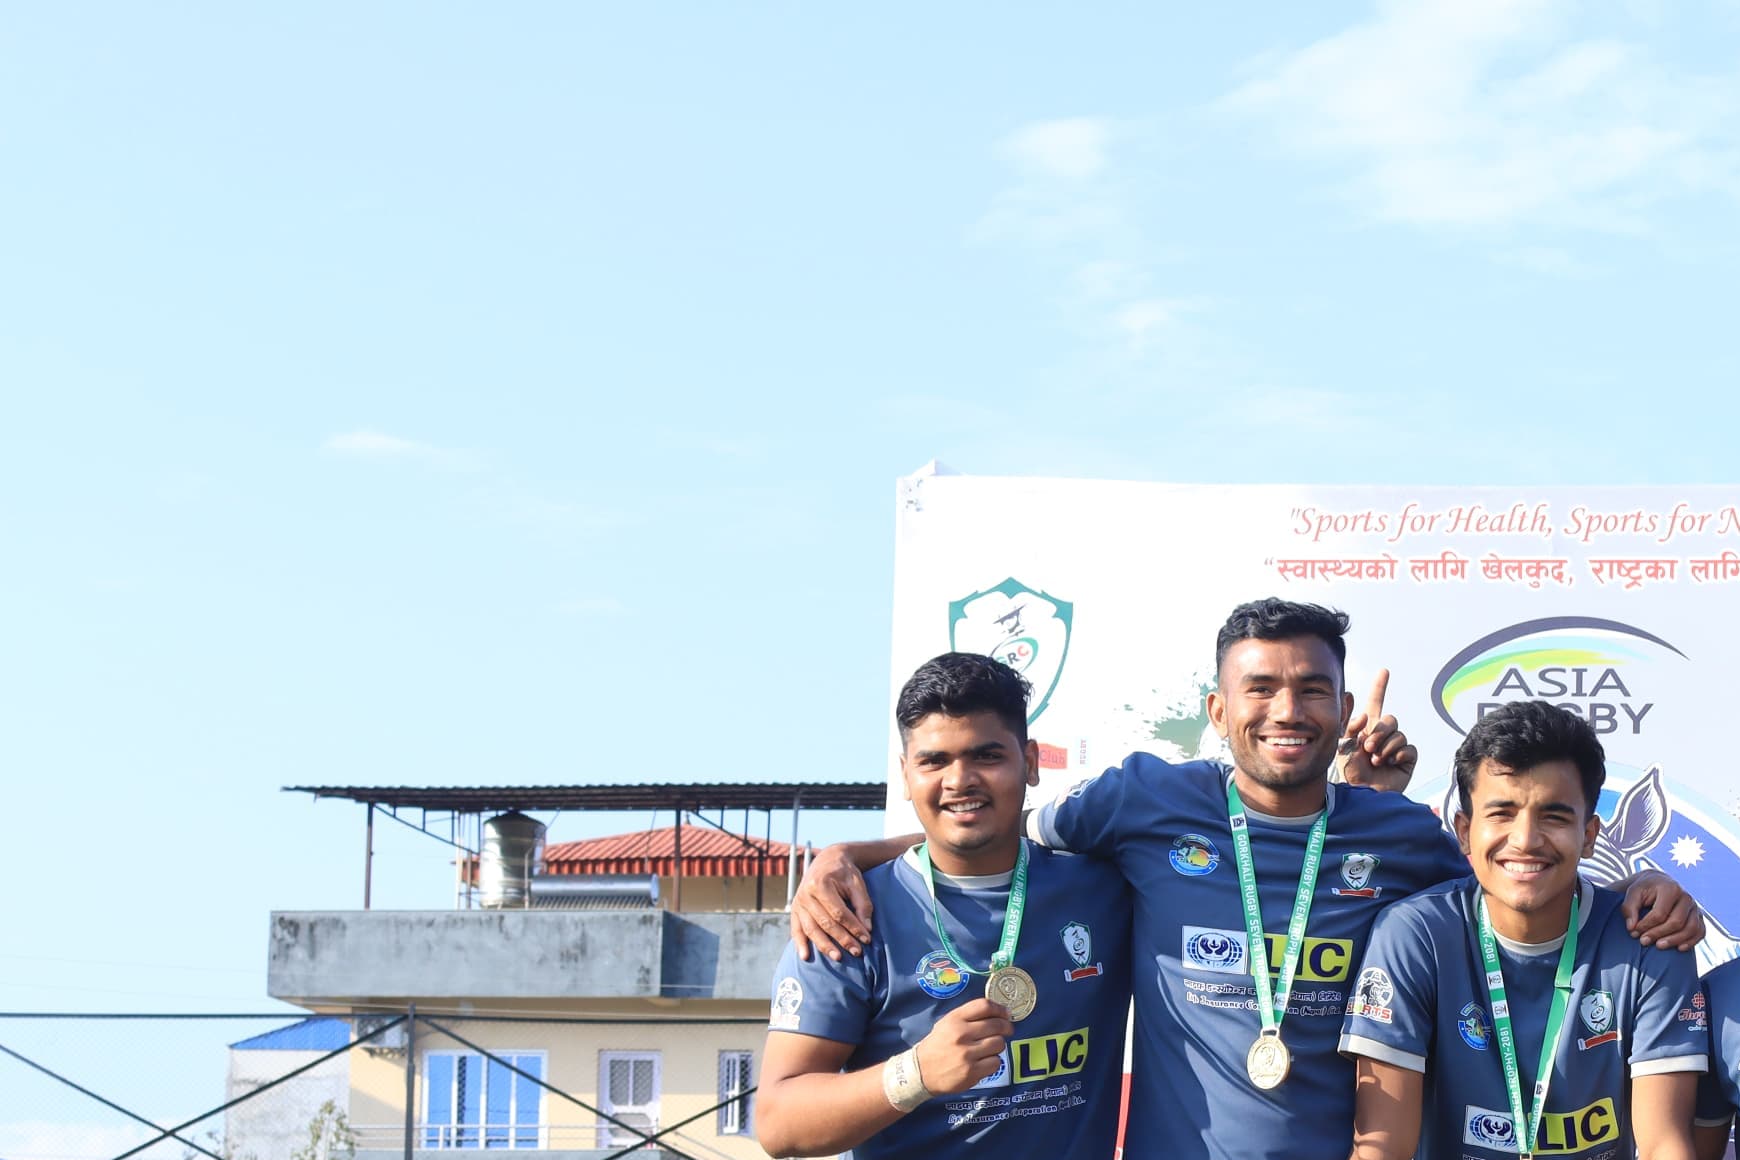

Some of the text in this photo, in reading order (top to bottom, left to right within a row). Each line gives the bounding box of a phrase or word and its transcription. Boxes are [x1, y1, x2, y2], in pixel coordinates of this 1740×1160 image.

[1291, 507, 1387, 542] "Sports
[1387, 503, 1442, 542] for
[1445, 504, 1553, 537] Health,
[1563, 507, 1657, 543] Sports
[1657, 503, 1712, 543] for
[1409, 551, 1469, 582] लागि
[1481, 553, 1573, 588] खेलकुद,
[1589, 559, 1678, 589] राष्ट्रका
[1492, 667, 1632, 697] ASIA
[1040, 750, 1066, 766] Club
[1237, 834, 1253, 882] GORKHALI
[1302, 854, 1317, 887] RUGBY
[1011, 879, 1024, 907] RUGBY
[1244, 884, 1257, 919] RUGBY
[1294, 887, 1311, 920] SEVEN
[1007, 908, 1020, 937] SEVEN
[1249, 919, 1260, 953] SEVEN
[1019, 1033, 1084, 1078] LIC
[1500, 1026, 1519, 1090] TROPHY-2081
[1537, 1105, 1611, 1150] LIC
